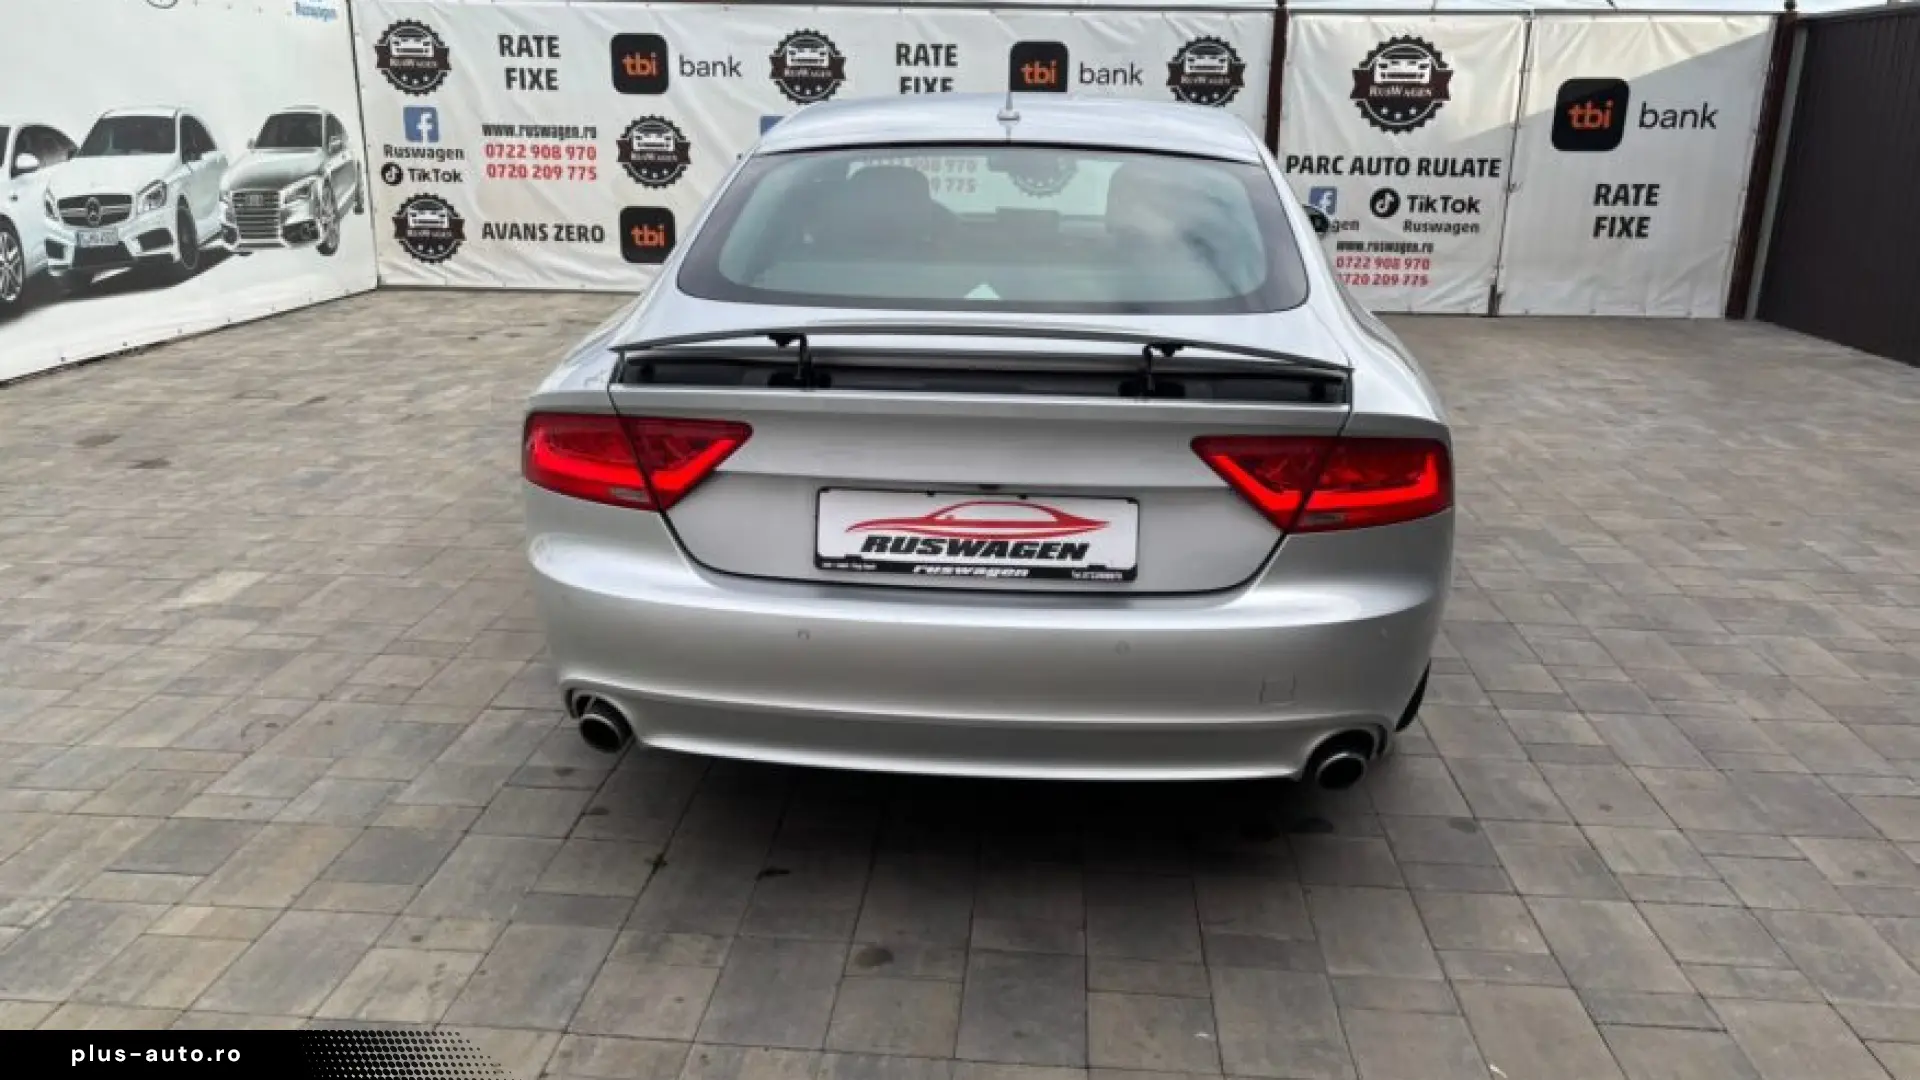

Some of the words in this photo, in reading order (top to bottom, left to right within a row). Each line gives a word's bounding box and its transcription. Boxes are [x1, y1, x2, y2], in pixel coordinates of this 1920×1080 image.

[498, 35, 560, 57] RATE
[896, 43, 958, 67] RATE
[623, 54, 657, 76] tbi
[679, 55, 742, 78] bank
[1022, 62, 1056, 85] tbi
[1080, 63, 1143, 86] bank
[505, 68, 559, 91] FIXE
[1568, 100, 1613, 129] tbi
[1638, 101, 1718, 129] bank
[383, 144, 464, 161] Ruswagen
[485, 144, 526, 158] 0722
[531, 145, 561, 159] 908
[565, 145, 596, 160] 970
[408, 168, 463, 183] TikTok
[486, 164, 526, 178] 0720
[532, 165, 561, 179] 209
[567, 166, 597, 180] 775
[1286, 155, 1344, 175] PARC
[1349, 156, 1410, 176] AUTO
[1416, 157, 1501, 177] RULATE
[1405, 195, 1481, 214] TikTok
[1593, 184, 1660, 206] RATE
[481, 224, 549, 241] AVANS
[554, 224, 604, 243] ZERO
[631, 225, 665, 246] tbi
[1403, 220, 1479, 235] Ruswagen
[1593, 217, 1650, 238] FIXE
[1337, 256, 1370, 268] 0722
[1405, 258, 1430, 270] 970
[1372, 273, 1399, 285] 209
[861, 535, 1090, 560] RUSWAGEN
[914, 564, 1029, 579] ruswagen
